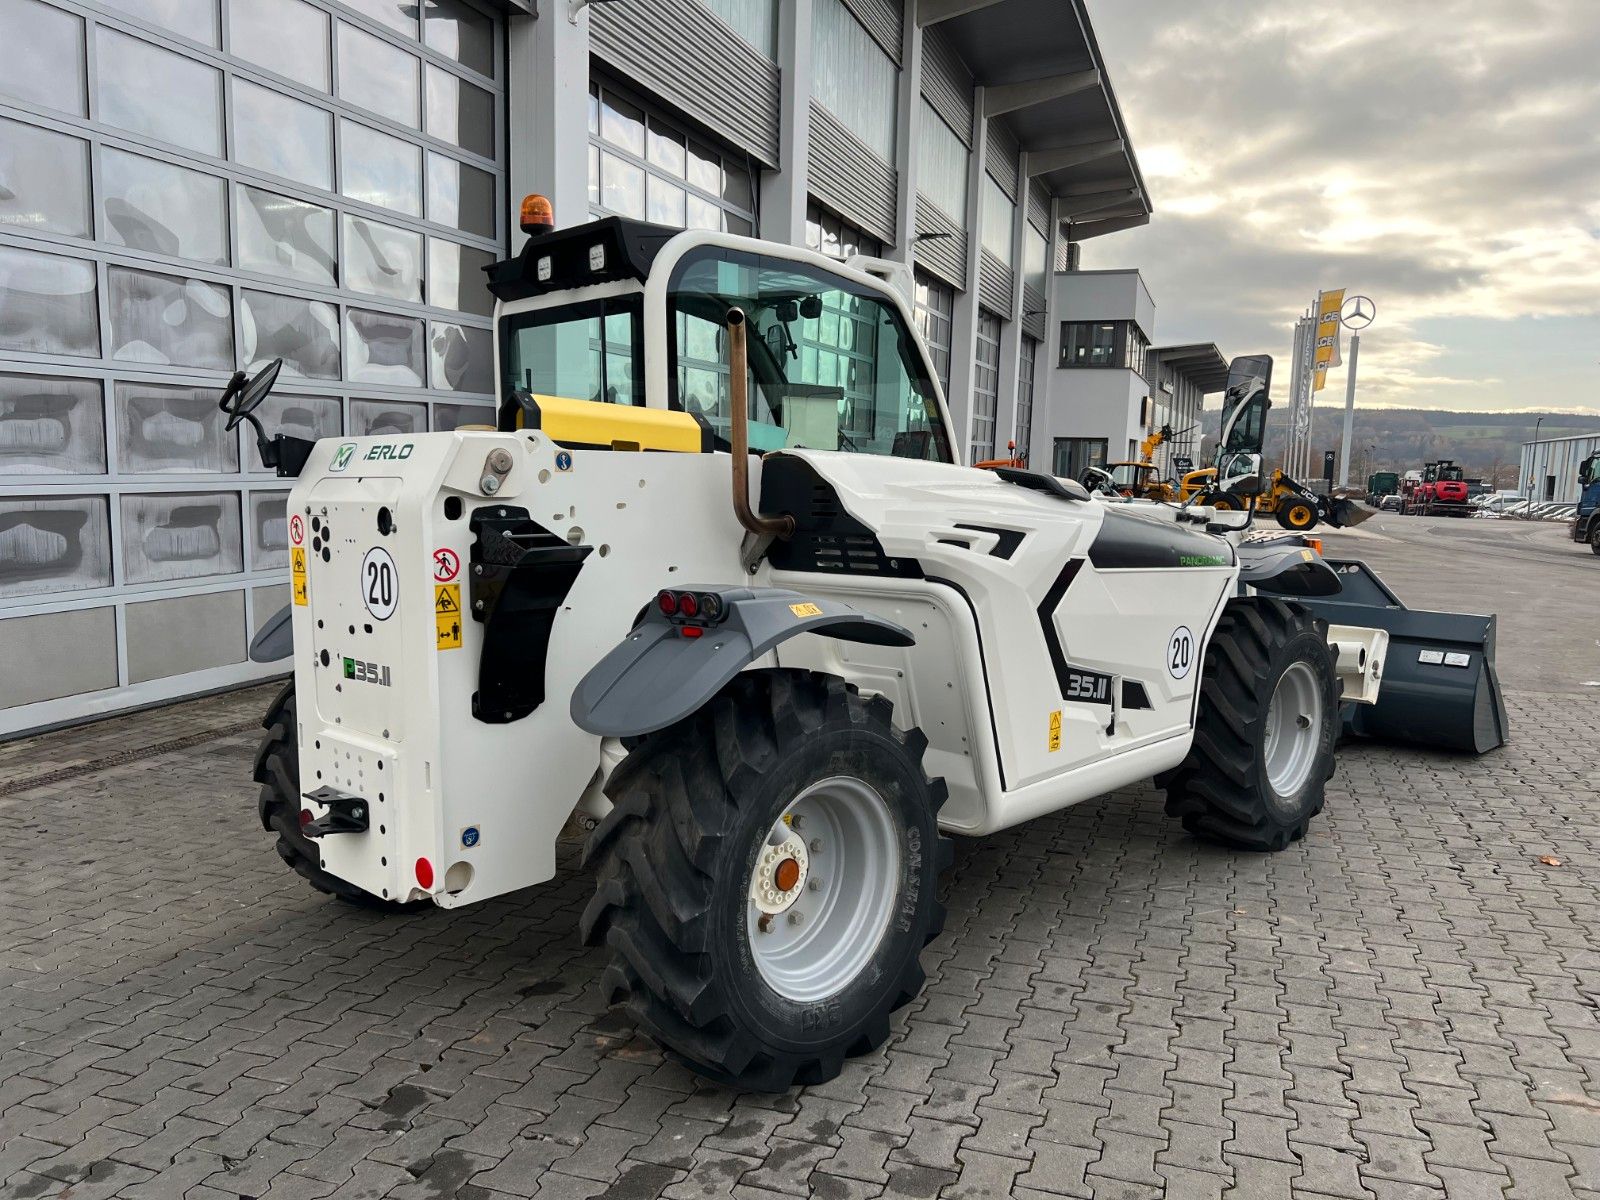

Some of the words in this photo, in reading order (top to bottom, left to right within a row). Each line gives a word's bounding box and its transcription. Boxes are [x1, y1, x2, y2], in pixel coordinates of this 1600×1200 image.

[1300, 489, 1319, 503] JCB
[367, 560, 391, 606] 20
[1172, 637, 1188, 669] 20
